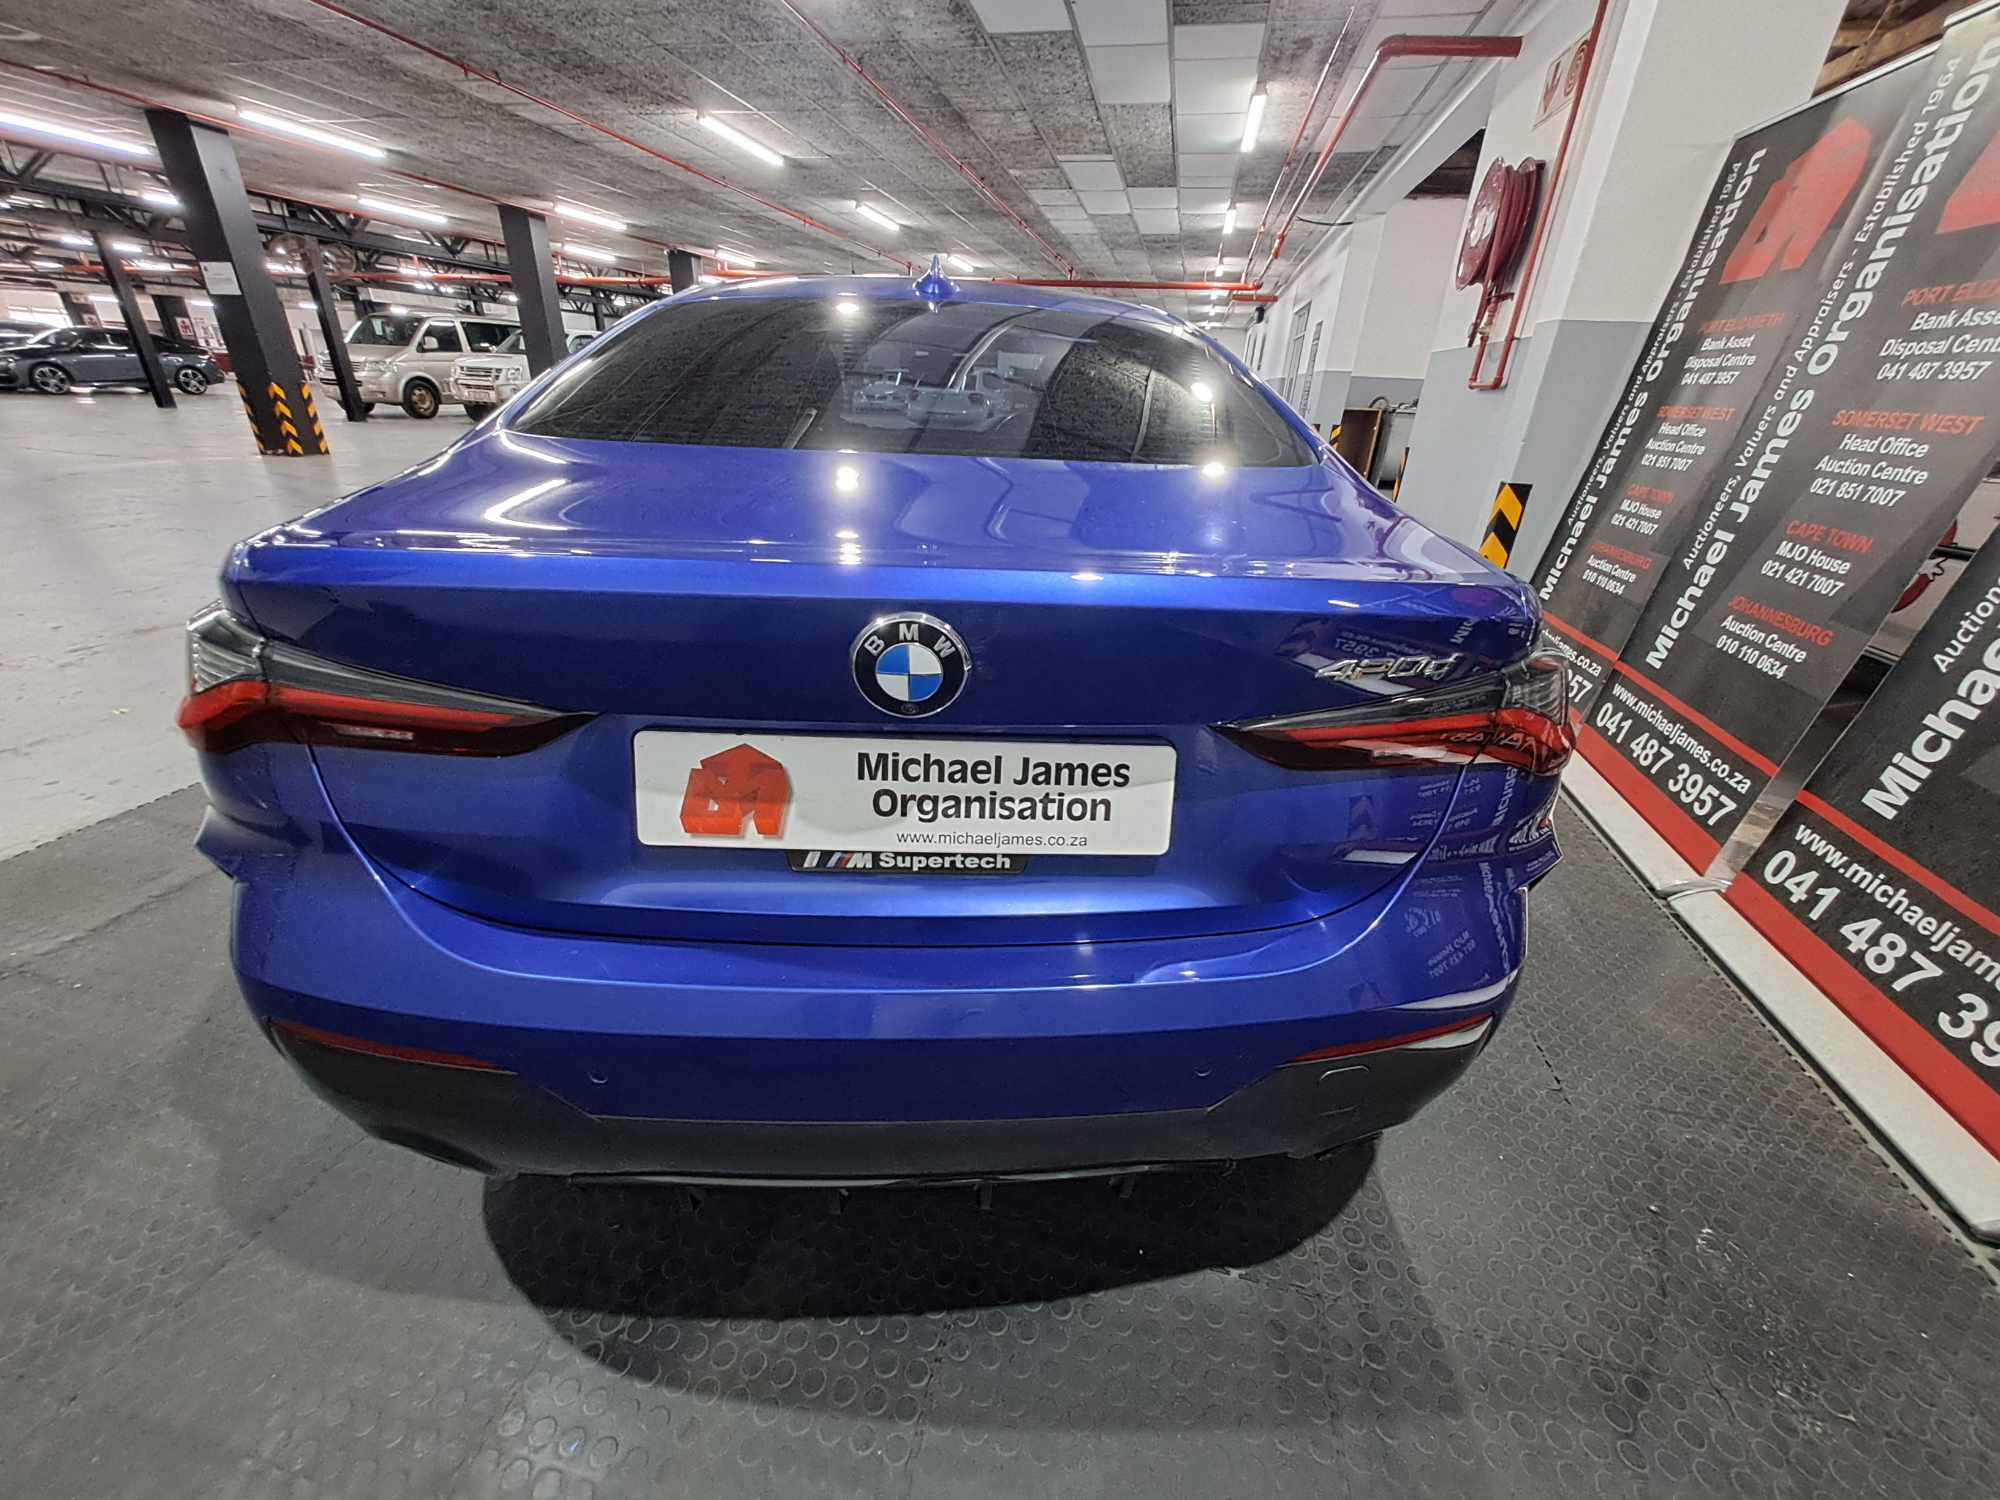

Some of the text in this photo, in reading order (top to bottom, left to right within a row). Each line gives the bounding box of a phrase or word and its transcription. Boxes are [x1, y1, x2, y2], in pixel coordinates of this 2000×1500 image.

[1628, 375, 1643, 401] and
[1680, 205, 1724, 288] Established
[1719, 162, 1742, 200] 1964
[1682, 475, 1742, 571] Auctioneers,
[1735, 404, 1777, 468] Valuers
[1774, 365, 1797, 401] and
[1794, 262, 1854, 363] Appraisers
[1854, 121, 1928, 244] Established
[1922, 56, 1962, 115] 1964
[1909, 309, 1959, 331] Bank
[1645, 528, 1735, 669] Michael
[1729, 388, 1815, 522] James
[1807, 38, 2000, 375] Organisation
[1725, 334, 1756, 348] Asset
[1879, 335, 1955, 360] Disposal
[1539, 495, 1598, 600] Michael
[1595, 391, 1648, 489] James
[1646, 148, 1768, 382] Organisation
[1722, 354, 1757, 367] Centre
[1876, 360, 1993, 380] 041 487 3957
[1658, 422, 1683, 436] Head
[1832, 409, 1984, 436] SOMERSET WEST
[1645, 438, 1706, 456] Auction Centre
[1839, 433, 1930, 458] Head Office
[1814, 454, 1929, 485] Auction Centre
[1810, 477, 1906, 507] 021 851 7007
[1638, 503, 1662, 519] House
[1785, 519, 1875, 555] CAPE TOWN
[1586, 554, 1614, 574] Auction
[1611, 563, 1637, 583] Centre
[1775, 540, 1852, 575] MJO House
[1760, 559, 1845, 598] 021 421 7007
[1720, 614, 1808, 663] Auction Centre
[1728, 595, 1836, 648] JOHANNESBURG
[1933, 576, 2000, 673] Auction
[864, 622, 956, 659] BMW
[1716, 634, 1788, 680] 010 110 0634
[1315, 652, 1463, 681] 420d
[1567, 668, 1593, 703] 57
[1612, 683, 1752, 795] www.michaeljames.co.za
[857, 752, 1131, 788] Michael James
[1596, 702, 1737, 826] 041 487 3957
[872, 788, 1112, 823] Organisation
[896, 831, 1088, 848] www.michaeljames.co.za
[879, 852, 1011, 871] Supertech
[1763, 850, 1841, 921] 041
[1840, 917, 1944, 992] 487
[1794, 823, 2000, 992] www.michaeljam
